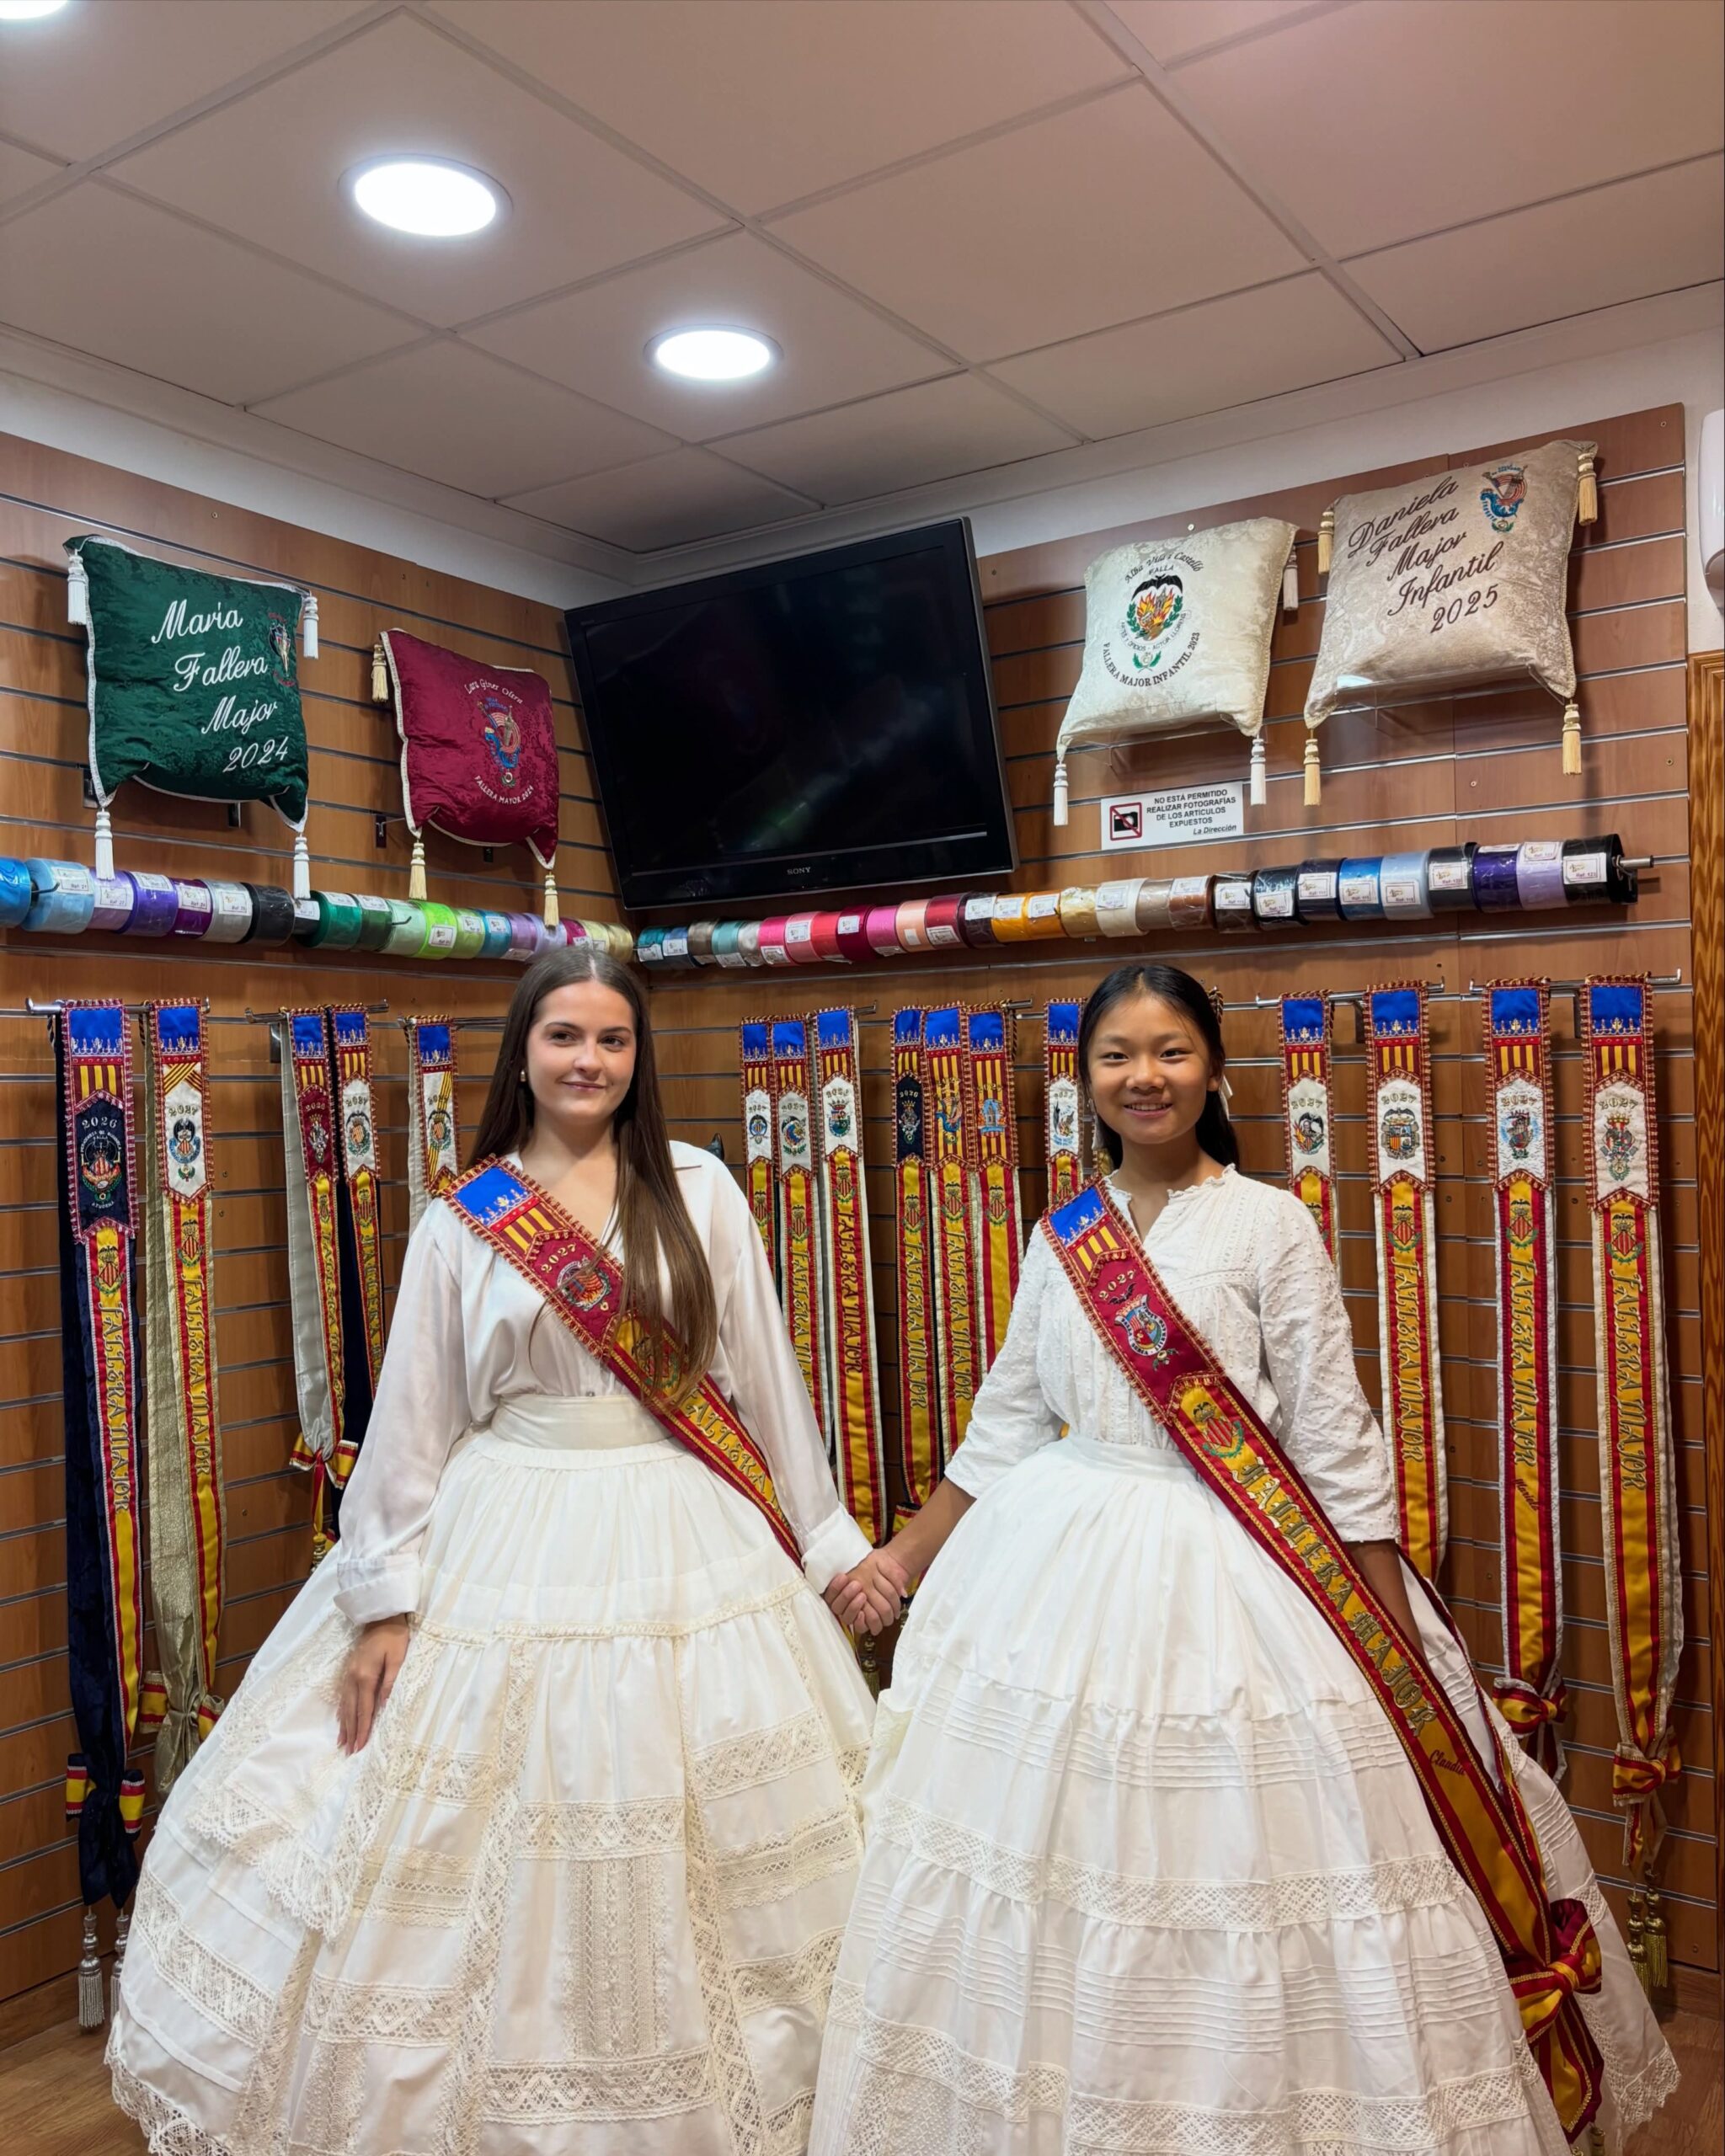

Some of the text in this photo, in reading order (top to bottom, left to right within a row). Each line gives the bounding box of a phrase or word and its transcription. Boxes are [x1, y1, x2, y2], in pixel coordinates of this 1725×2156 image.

[1348, 476, 1459, 558] Daniela
[1365, 507, 1460, 567] Fallera
[1386, 531, 1467, 581] Major
[1387, 541, 1504, 616] Infantil
[1430, 584, 1499, 634] 2025
[173, 646, 268, 691] Fallera
[1103, 632, 1200, 687] FALLERA MAJOR INFANTIL 2023
[201, 695, 278, 734] Major
[222, 736, 288, 772] 2024
[474, 775, 497, 800] FALLERA
[499, 795, 521, 804] MAYOR
[1146, 796, 1236, 814] REALIZAR FOTOGRAFÍAS
[1167, 792, 1186, 803] ESTÁ
[1187, 789, 1227, 801] PERMITIDO
[1168, 812, 1183, 820] LOS
[1169, 816, 1213, 828] EXPUESTOS
[1203, 825, 1236, 835] Dirección
[787, 866, 811, 875] SONY
[1381, 1092, 1417, 1105] 2027
[1598, 1097, 1639, 1110] 2027
[82, 1117, 117, 1129] 2026
[541, 1243, 576, 1273] 2027
[837, 1209, 863, 1379] FALLERA MAJOR
[1098, 1269, 1136, 1300] 2027
[904, 1239, 928, 1410] FALLERA MAJOR
[943, 1226, 973, 1401] FALLERA MAJOR
[180, 1273, 211, 1475] FALLERA MAJOR
[1391, 1256, 1425, 1462] FALLERA MAJOR
[1508, 1253, 1539, 1467] FALLERA MAJOR
[1610, 1269, 1648, 1491] FALLERA MAJOR
[98, 1301, 132, 1512] FALLERA MAJOR
[1232, 1456, 1438, 1737] FALLERA MAJOR
